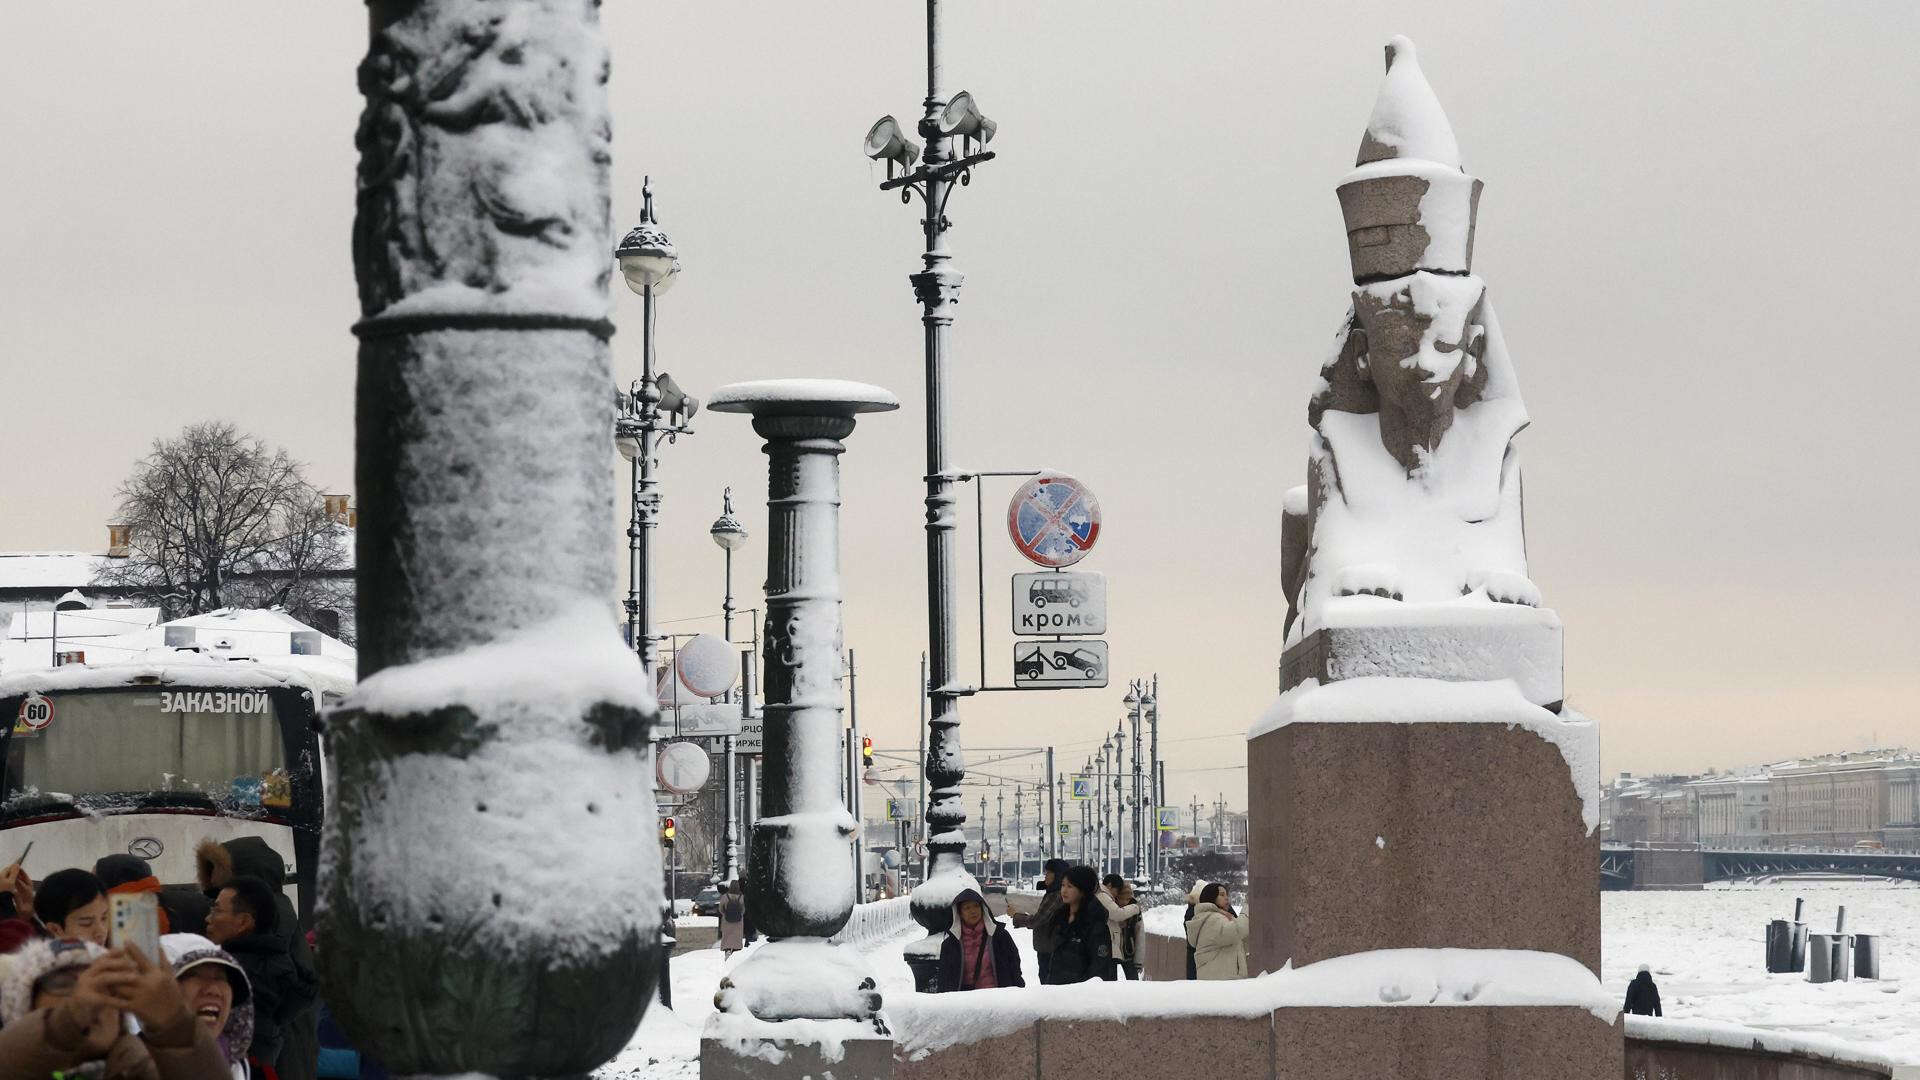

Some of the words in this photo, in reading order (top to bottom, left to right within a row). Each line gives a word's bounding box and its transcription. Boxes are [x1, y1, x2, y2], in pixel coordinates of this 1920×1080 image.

[1023, 614, 1097, 631] кроме
[160, 690, 268, 713] ЗАКАЗНОЙ
[28, 704, 47, 720] 60
[741, 725, 763, 733] РЦО
